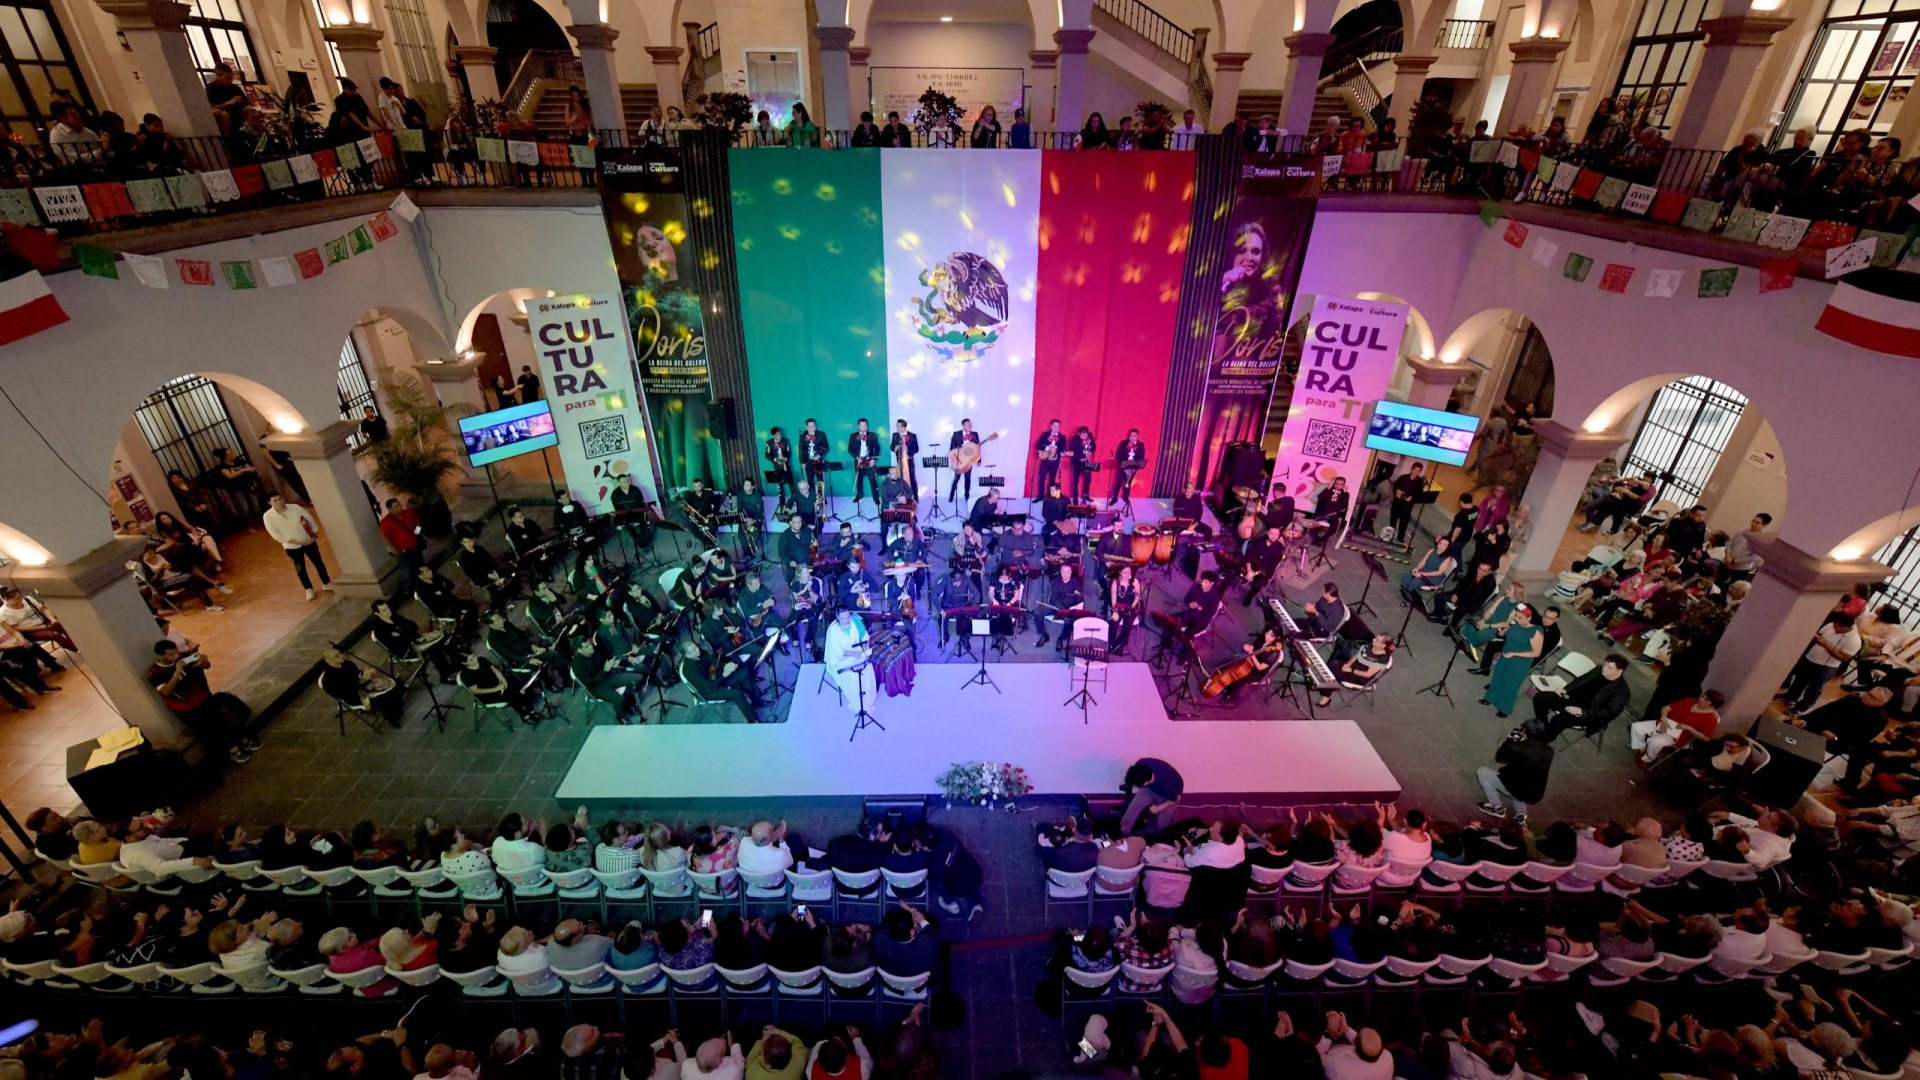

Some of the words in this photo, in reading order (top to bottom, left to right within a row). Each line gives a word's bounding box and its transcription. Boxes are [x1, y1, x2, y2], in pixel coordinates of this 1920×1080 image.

[616, 164, 643, 172] Xalapa
[1254, 168, 1280, 176] Xalapa
[551, 302, 576, 310] Xalapa
[581, 299, 609, 308] Cultura
[1339, 304, 1364, 313] Xalapa
[1370, 309, 1398, 318] Cultura
[539, 318, 615, 346] CUL
[628, 304, 705, 363] Doris
[1211, 306, 1283, 364] Doris
[1315, 321, 1389, 351] CUL
[543, 345, 594, 372] TU
[1311, 345, 1359, 371] TU
[553, 369, 608, 397] RA
[1305, 369, 1355, 397] RA
[565, 399, 596, 412] para
[596, 389, 628, 411] TI
[1305, 397, 1337, 409] para
